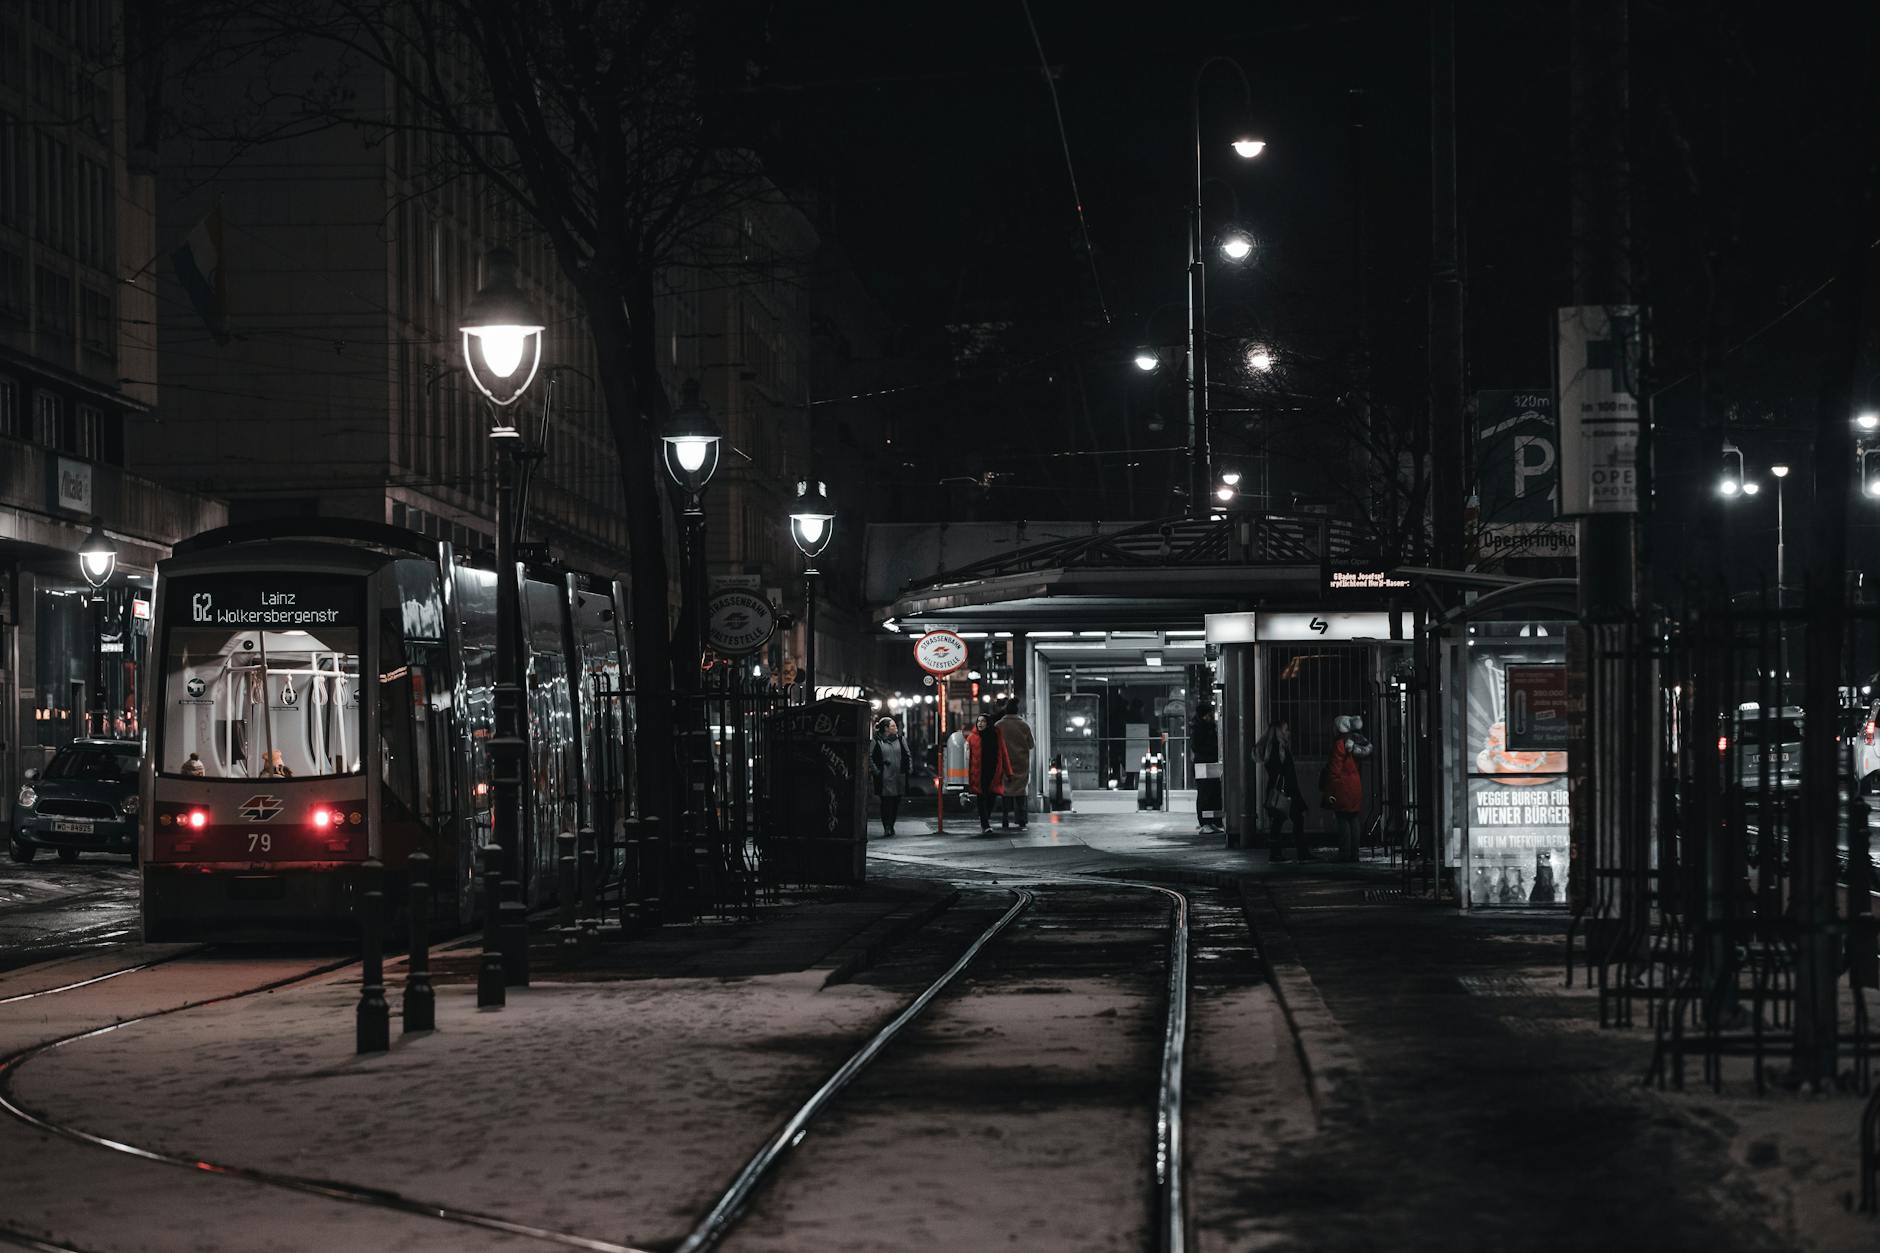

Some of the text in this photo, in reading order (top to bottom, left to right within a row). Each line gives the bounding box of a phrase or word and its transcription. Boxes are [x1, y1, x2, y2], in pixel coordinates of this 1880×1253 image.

[1514, 435, 1556, 499] P
[1592, 470, 1632, 484] OPE
[192, 591, 296, 622] 62 Lainz
[217, 608, 339, 624] Wolkersbergenstr
[921, 635, 961, 650] STRASSENBAHN
[923, 656, 960, 669] HALTESTELLE
[1477, 789, 1569, 806] VEGGIE BURGER FÜR
[1477, 805, 1570, 825] WIENER BÜRGER
[247, 833, 272, 853] 79
[1477, 835, 1494, 848] NEU
[1495, 835, 1507, 848] IM
